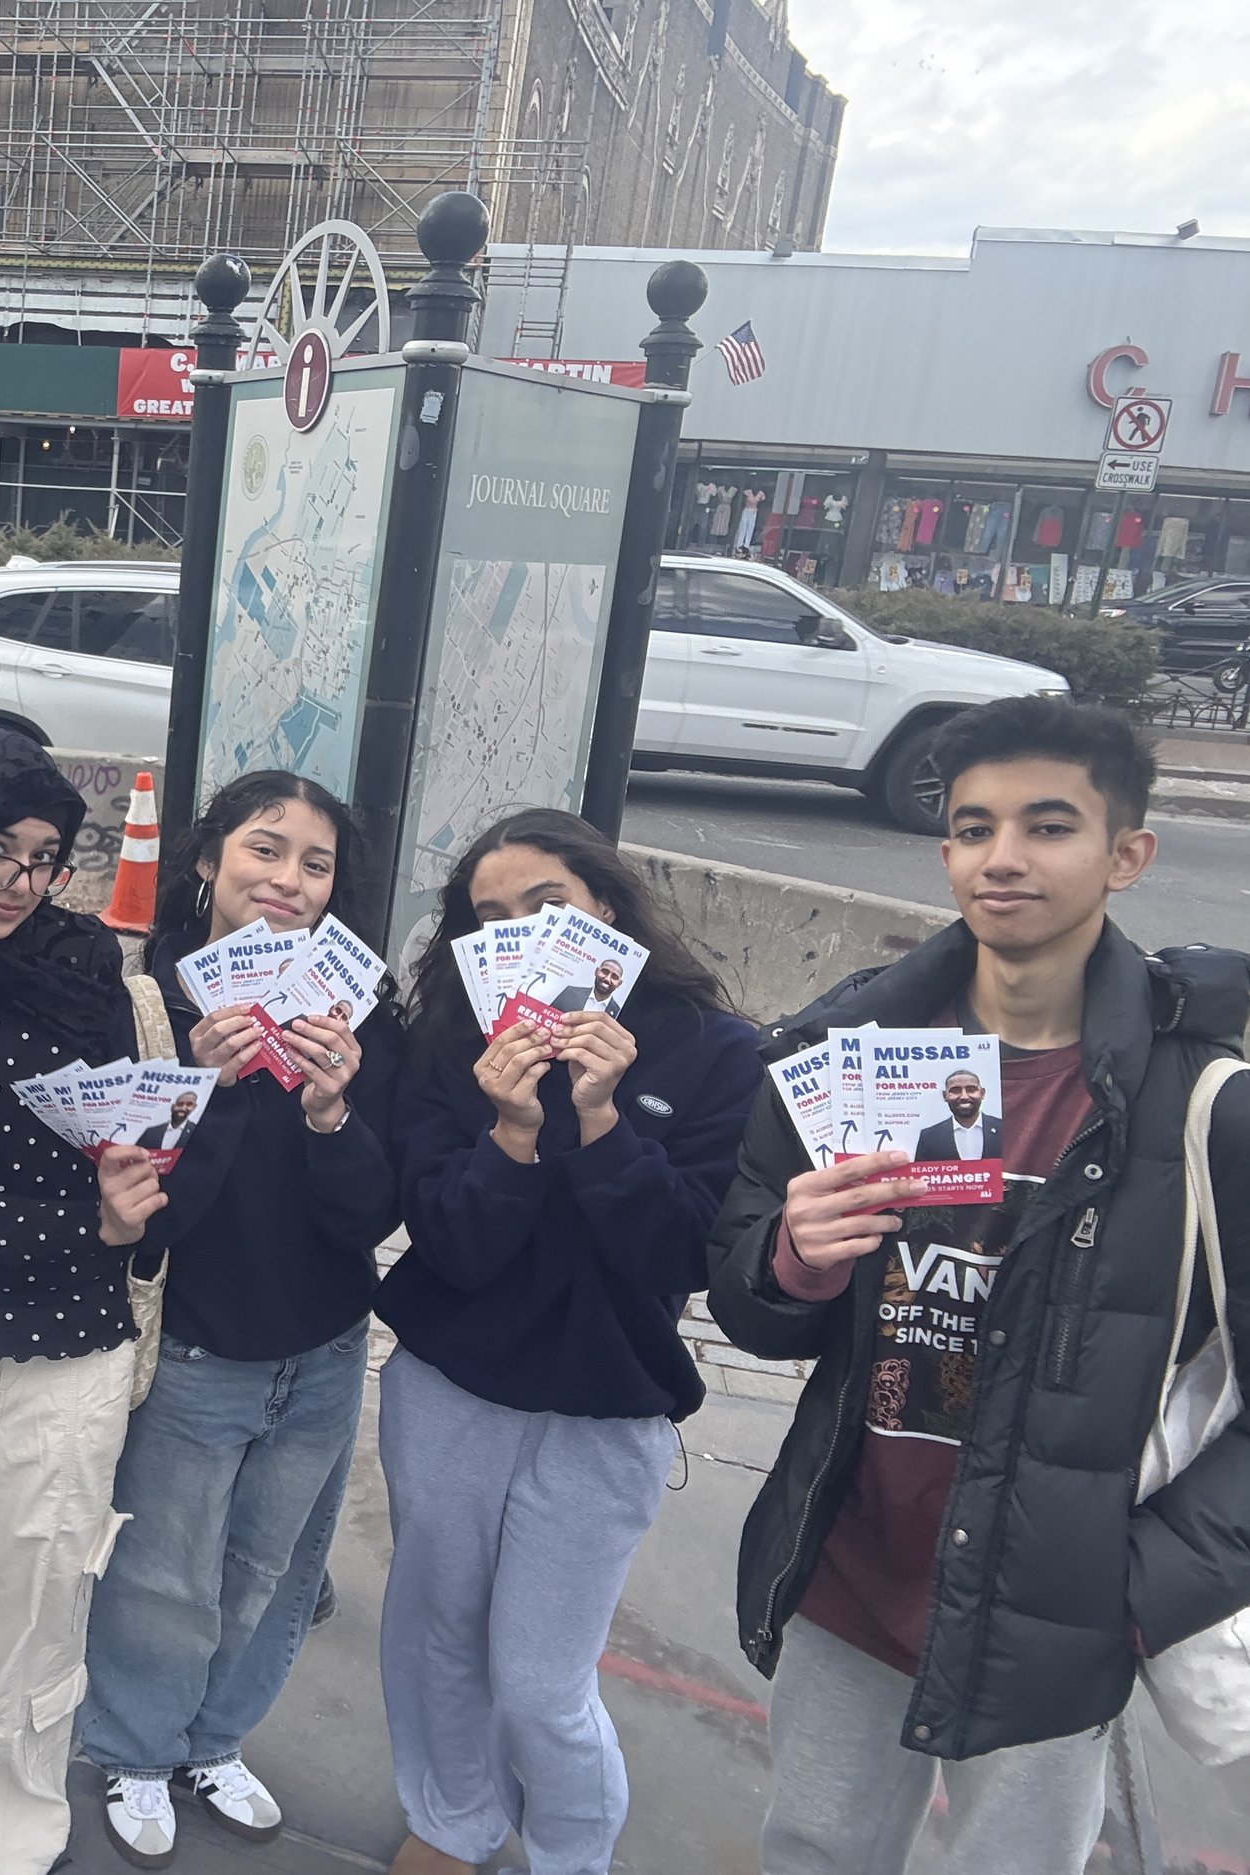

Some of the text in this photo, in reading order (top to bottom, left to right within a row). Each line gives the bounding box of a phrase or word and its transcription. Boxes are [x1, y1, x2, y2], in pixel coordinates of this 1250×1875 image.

[515, 361, 612, 384] RTIN
[133, 400, 194, 415] GREAT
[1132, 460, 1154, 472] USE
[1102, 472, 1151, 485] CROSSWALK
[466, 474, 611, 518] JOURNAL SQUARE
[494, 925, 535, 939] MUS
[560, 928, 586, 947] ALI
[567, 915, 629, 956] MUSSAB
[228, 939, 294, 958] MUSSAB
[326, 925, 373, 970] MUSSAB
[496, 941, 520, 953] ALI
[556, 938, 570, 951] FOR
[570, 946, 597, 963] MAYOR
[230, 959, 254, 972] ALI
[247, 970, 274, 979] MAYOR
[314, 960, 334, 981] ALI
[324, 950, 366, 1000] MUSSAB
[308, 968, 336, 1000] FOR MAYOR
[517, 1005, 542, 1024] REAL
[267, 1036, 303, 1074] CHANGE?
[874, 1046, 970, 1061] MUSSAB
[141, 1070, 202, 1085] MUSSAB
[876, 1065, 908, 1079] ALI
[81, 1091, 106, 1101] ALI
[136, 1083, 160, 1094] ALI
[791, 1077, 820, 1099] ALI
[797, 1098, 814, 1109] FOR
[920, 1172, 991, 1184] CHANGE?
[879, 1303, 976, 1333] OFF THE
[895, 1328, 964, 1352] SINCE
